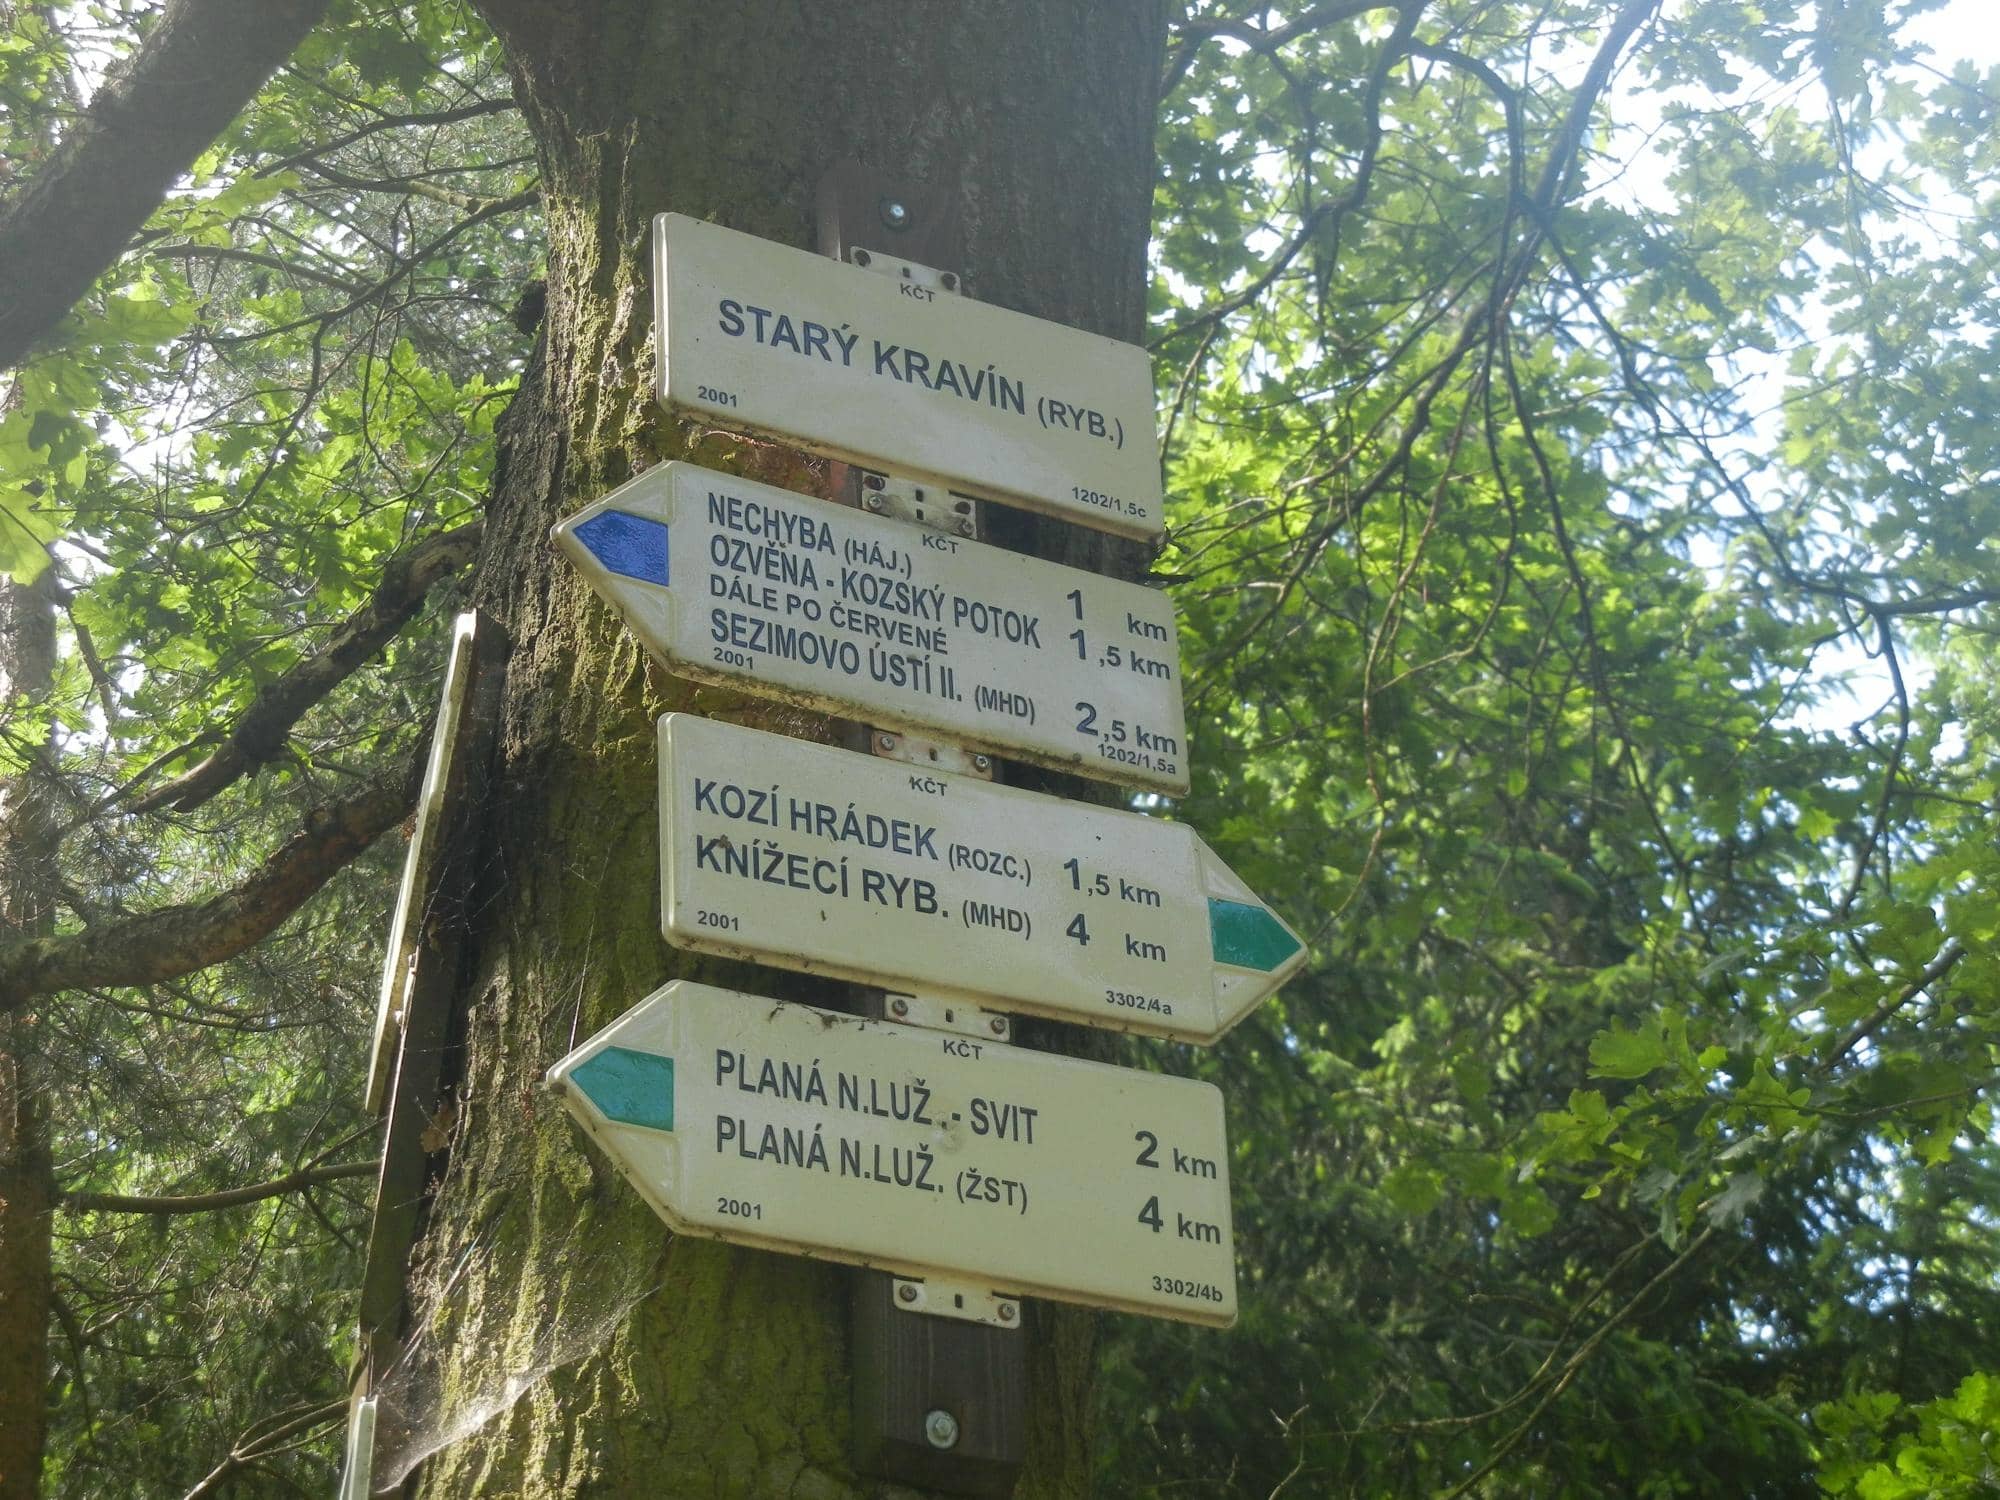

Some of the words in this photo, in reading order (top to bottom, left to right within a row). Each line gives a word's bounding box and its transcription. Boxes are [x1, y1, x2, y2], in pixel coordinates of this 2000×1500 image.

[900, 282, 934, 303] KČT
[719, 300, 859, 366] STARÝ
[874, 341, 1026, 414] KRAVÍN
[1038, 397, 1124, 449] (RYB.)
[698, 385, 737, 407] 2001
[1072, 486, 1146, 518] 1202/1,5c
[922, 534, 959, 554] KČT
[709, 492, 835, 555] NECHYBA
[844, 536, 912, 580] (HÁJ.)
[1067, 589, 1082, 620] 1
[1128, 613, 1167, 641] km
[711, 575, 777, 611] DÁLE
[787, 594, 821, 621] PO
[830, 600, 948, 654] ČERVENÉ
[841, 569, 945, 621] KOZSKÝ
[954, 597, 1041, 648] POTOK
[1130, 651, 1170, 679] km
[714, 647, 754, 670] 2001
[711, 609, 859, 675] SEZIMOVO
[870, 642, 931, 697] ÚSTÍ
[940, 665, 962, 702] II.
[975, 685, 1035, 724] (MHD)
[1075, 702, 1128, 742] 2,5
[1136, 726, 1177, 755] km
[1098, 743, 1176, 775] 1202/1,5a
[910, 776, 947, 797] KČT
[695, 778, 778, 827] KOZÍ
[790, 798, 938, 860] HRÁDEK
[949, 844, 1032, 886] (ROZC.)
[1120, 878, 1160, 907] km
[697, 835, 848, 898] KNÍŽECÍ
[863, 868, 949, 918] RYB.
[962, 900, 1031, 940] (MHD)
[1066, 913, 1090, 946] 4
[1126, 934, 1166, 962] km
[698, 911, 739, 931] 2001
[1106, 991, 1172, 1015] 3302/4a
[943, 1040, 982, 1060] KČT
[716, 1050, 827, 1106] PLANÁ
[970, 1097, 1038, 1144] SVIT
[1135, 1131, 1159, 1168] 2
[1174, 1148, 1216, 1179] km
[717, 1116, 829, 1172] PLANÁ
[841, 1137, 943, 1193] N.LUŽ.
[957, 1166, 1027, 1215] (ŽST)
[1138, 1196, 1163, 1233] 4
[1178, 1213, 1221, 1244] km
[717, 1198, 762, 1220] 2001
[1152, 1276, 1222, 1302] 3302/4b
